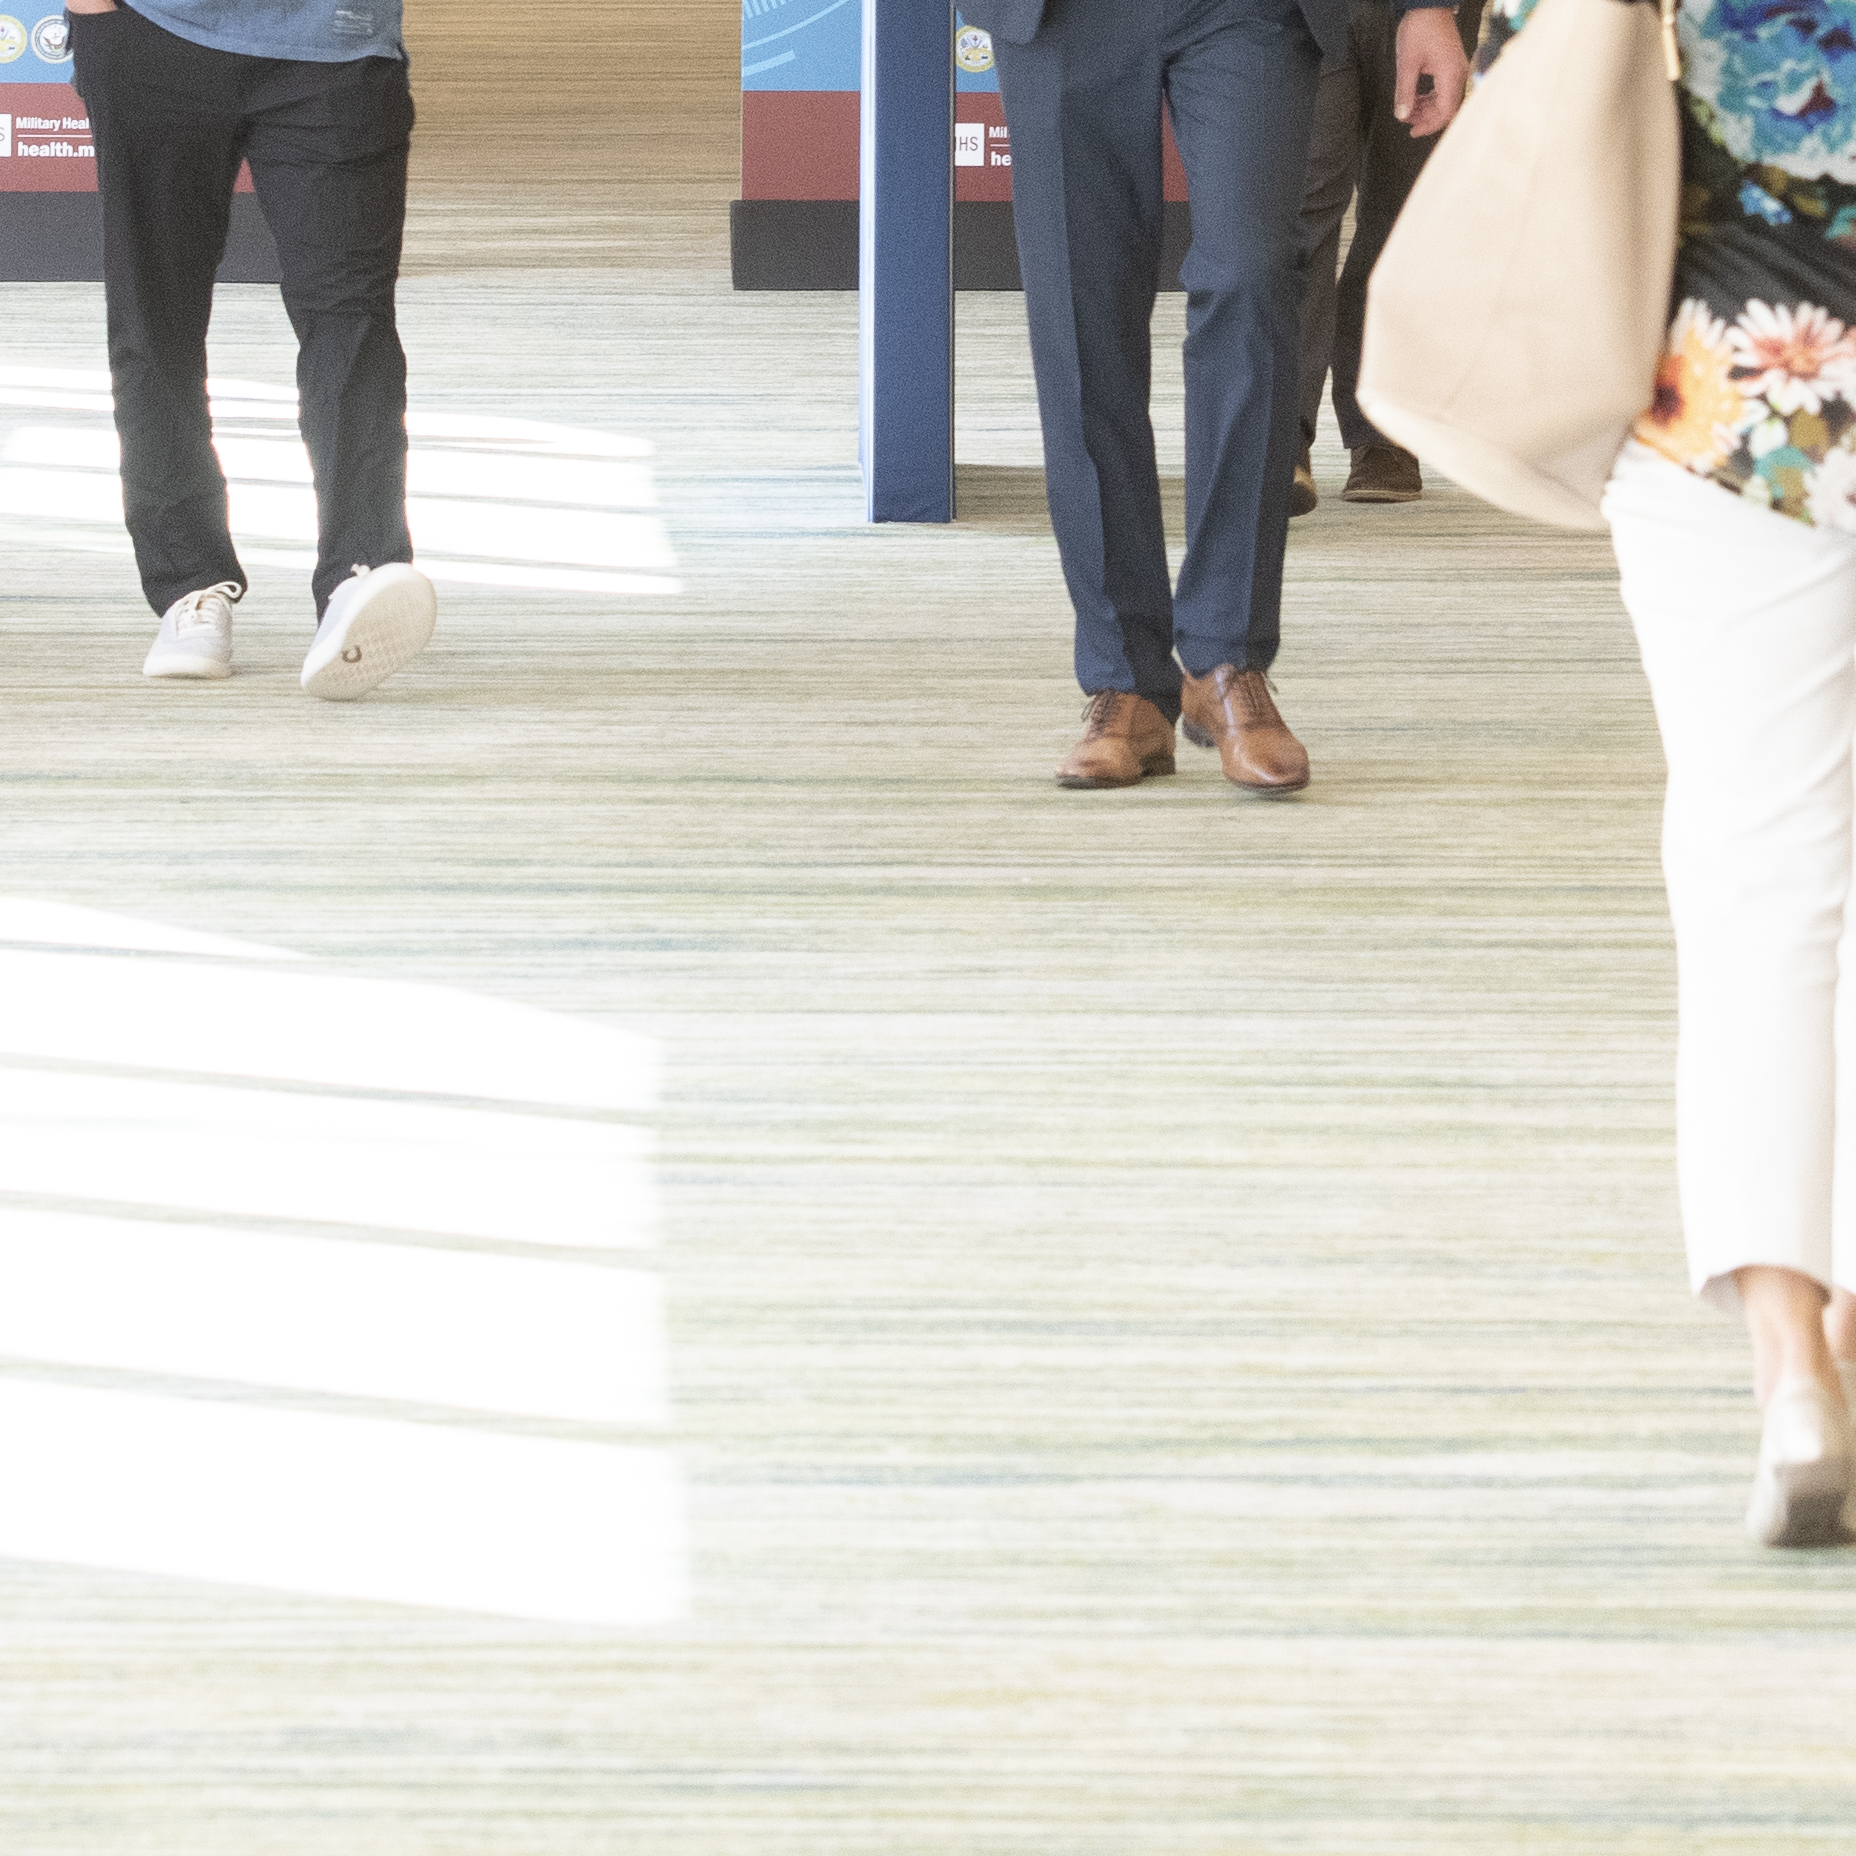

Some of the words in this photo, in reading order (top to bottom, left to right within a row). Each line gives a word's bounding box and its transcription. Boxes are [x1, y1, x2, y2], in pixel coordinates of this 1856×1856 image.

[15, 116, 61, 132] Military
[62, 117, 89, 130] Heal
[17, 141, 94, 157] health.m
[958, 136, 979, 152] HS
